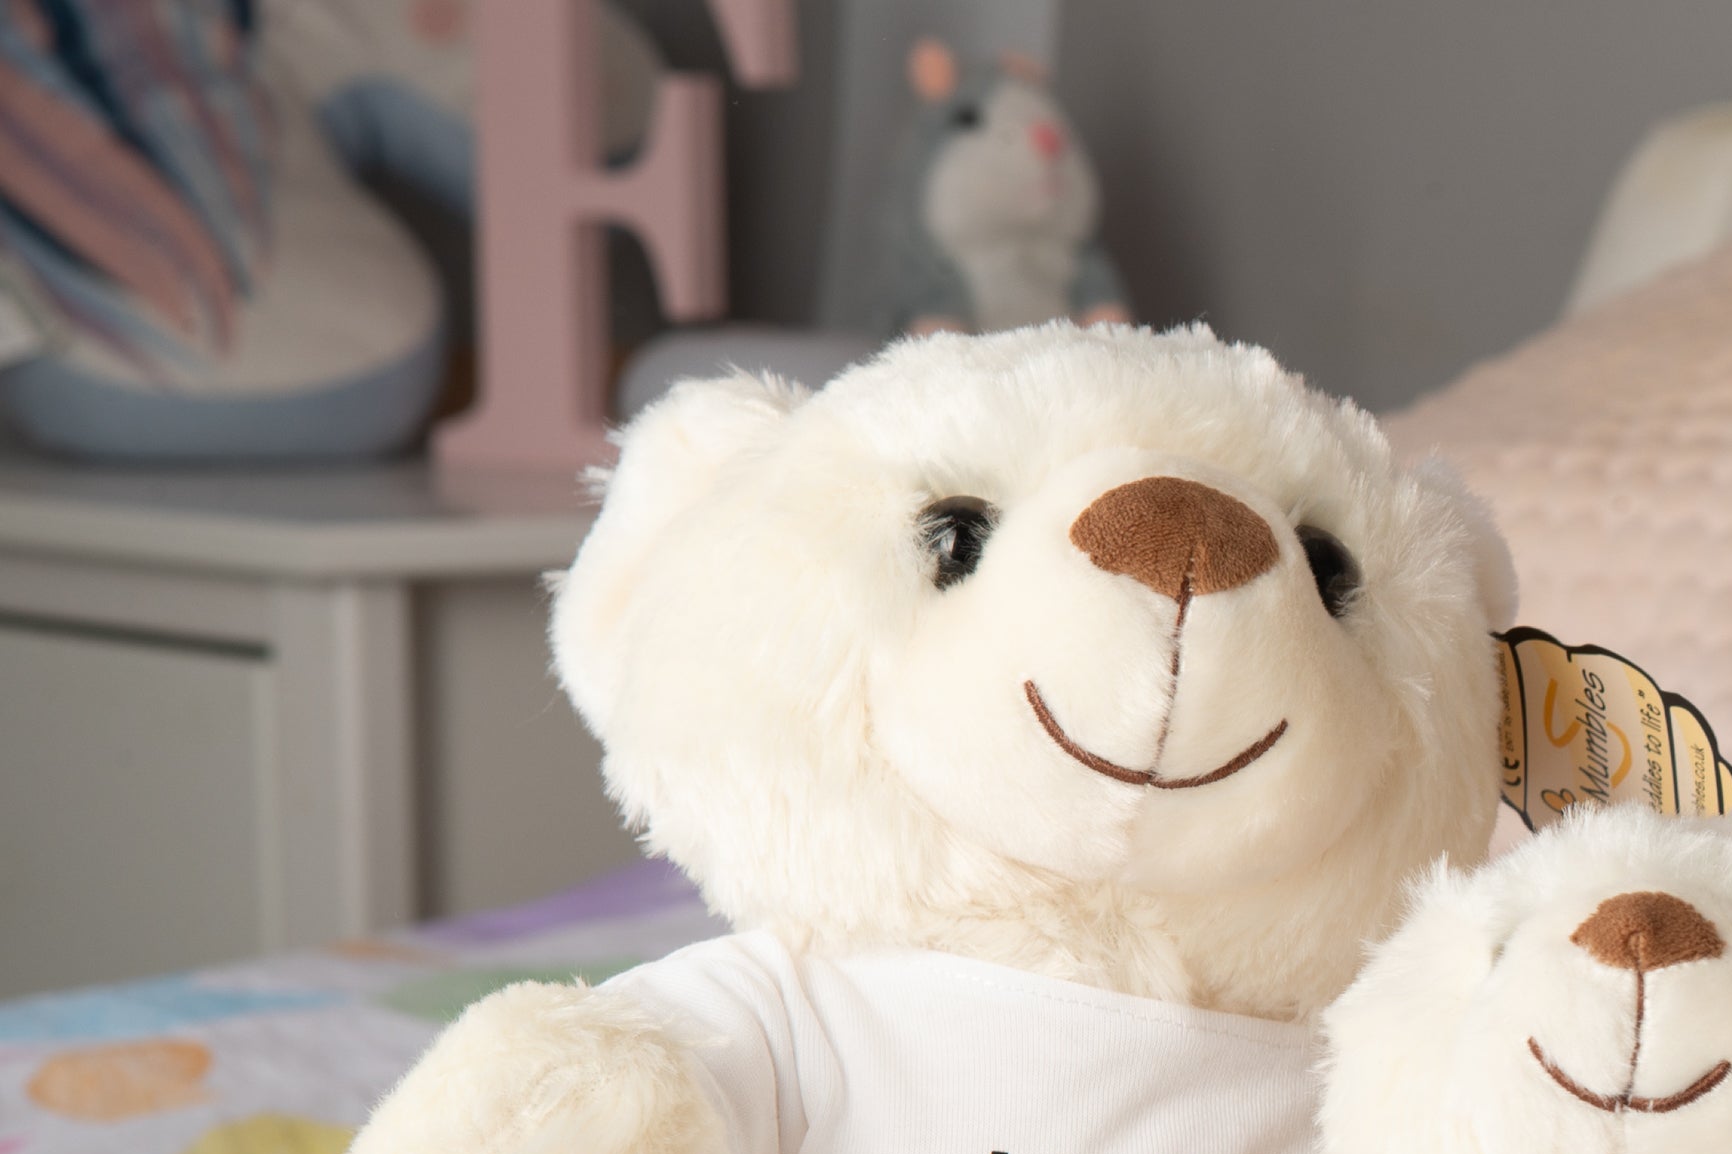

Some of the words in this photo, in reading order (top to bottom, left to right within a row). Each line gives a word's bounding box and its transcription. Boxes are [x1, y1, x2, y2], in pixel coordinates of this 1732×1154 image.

[1575, 669, 1609, 804] Mumbles
[1644, 735, 1662, 756] to
[1642, 759, 1663, 814] eddies
